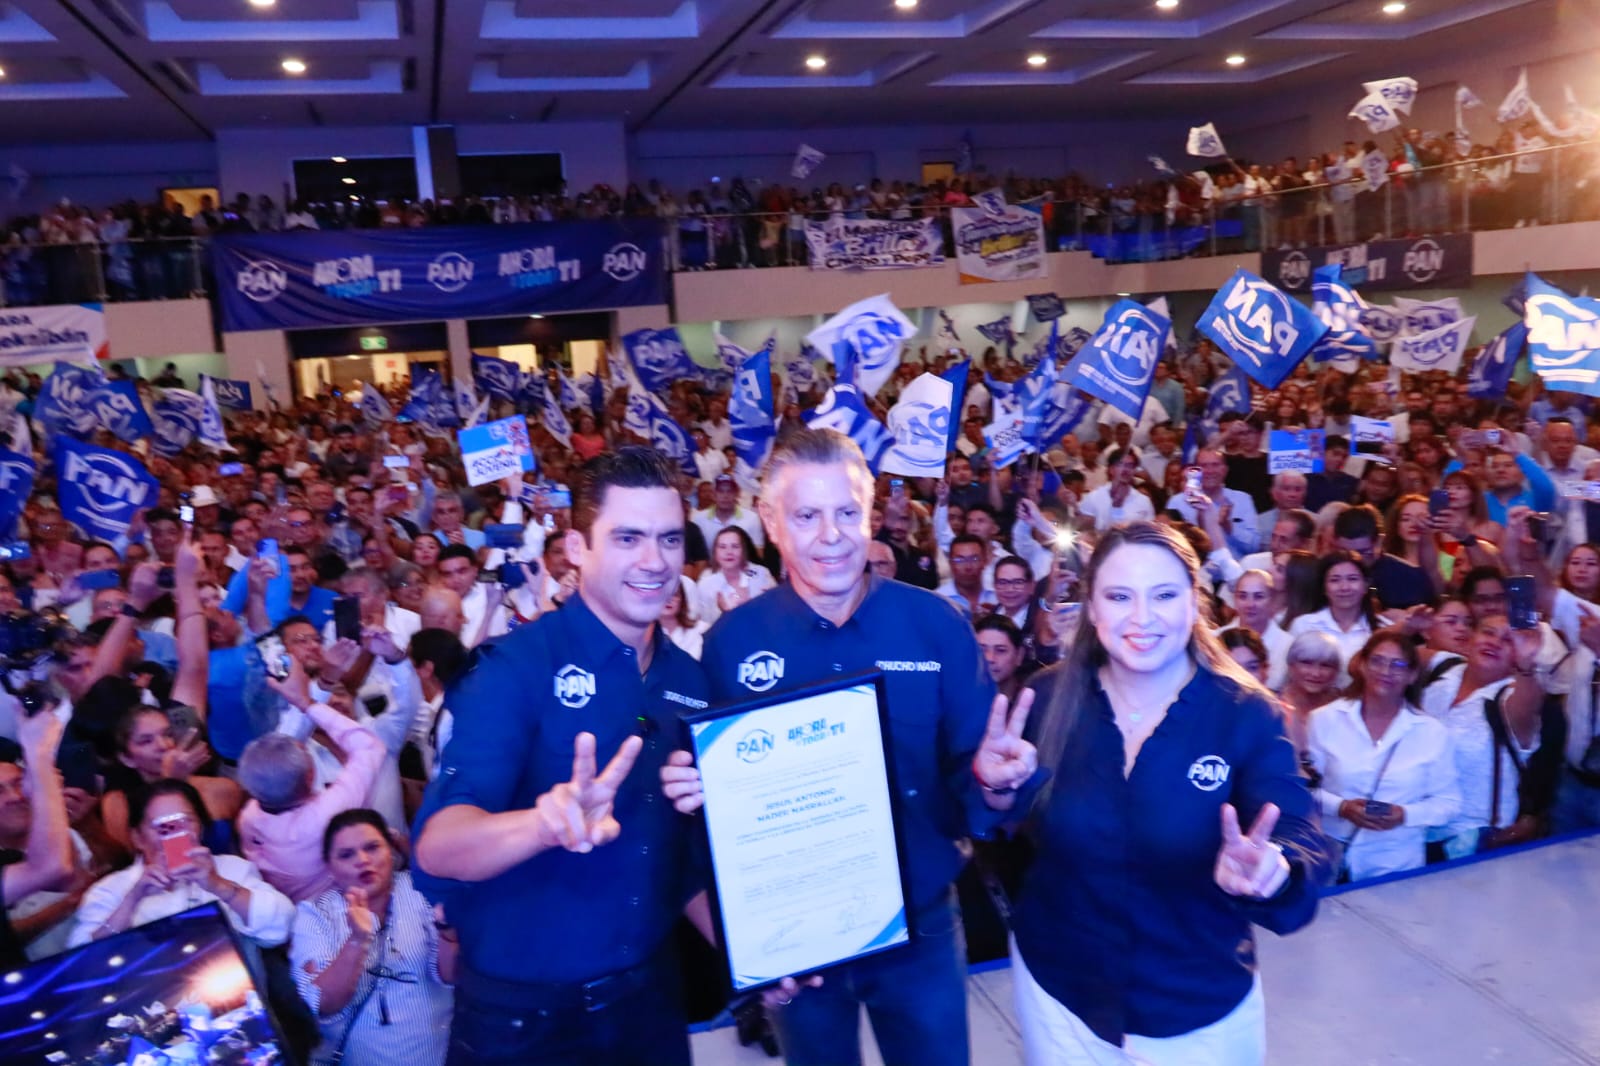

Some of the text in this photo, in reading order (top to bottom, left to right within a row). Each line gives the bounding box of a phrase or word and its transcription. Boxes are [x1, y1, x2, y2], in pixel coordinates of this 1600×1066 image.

[427, 261, 474, 283] PAN
[558, 259, 581, 281] TI
[602, 251, 646, 272] PAN
[1403, 249, 1444, 272] PAN
[237, 269, 287, 293] PAN
[376, 269, 401, 292] TI
[737, 658, 784, 684] PAN
[554, 672, 596, 698] PAN
[736, 734, 775, 759] PAN
[1187, 763, 1230, 782] PAN
